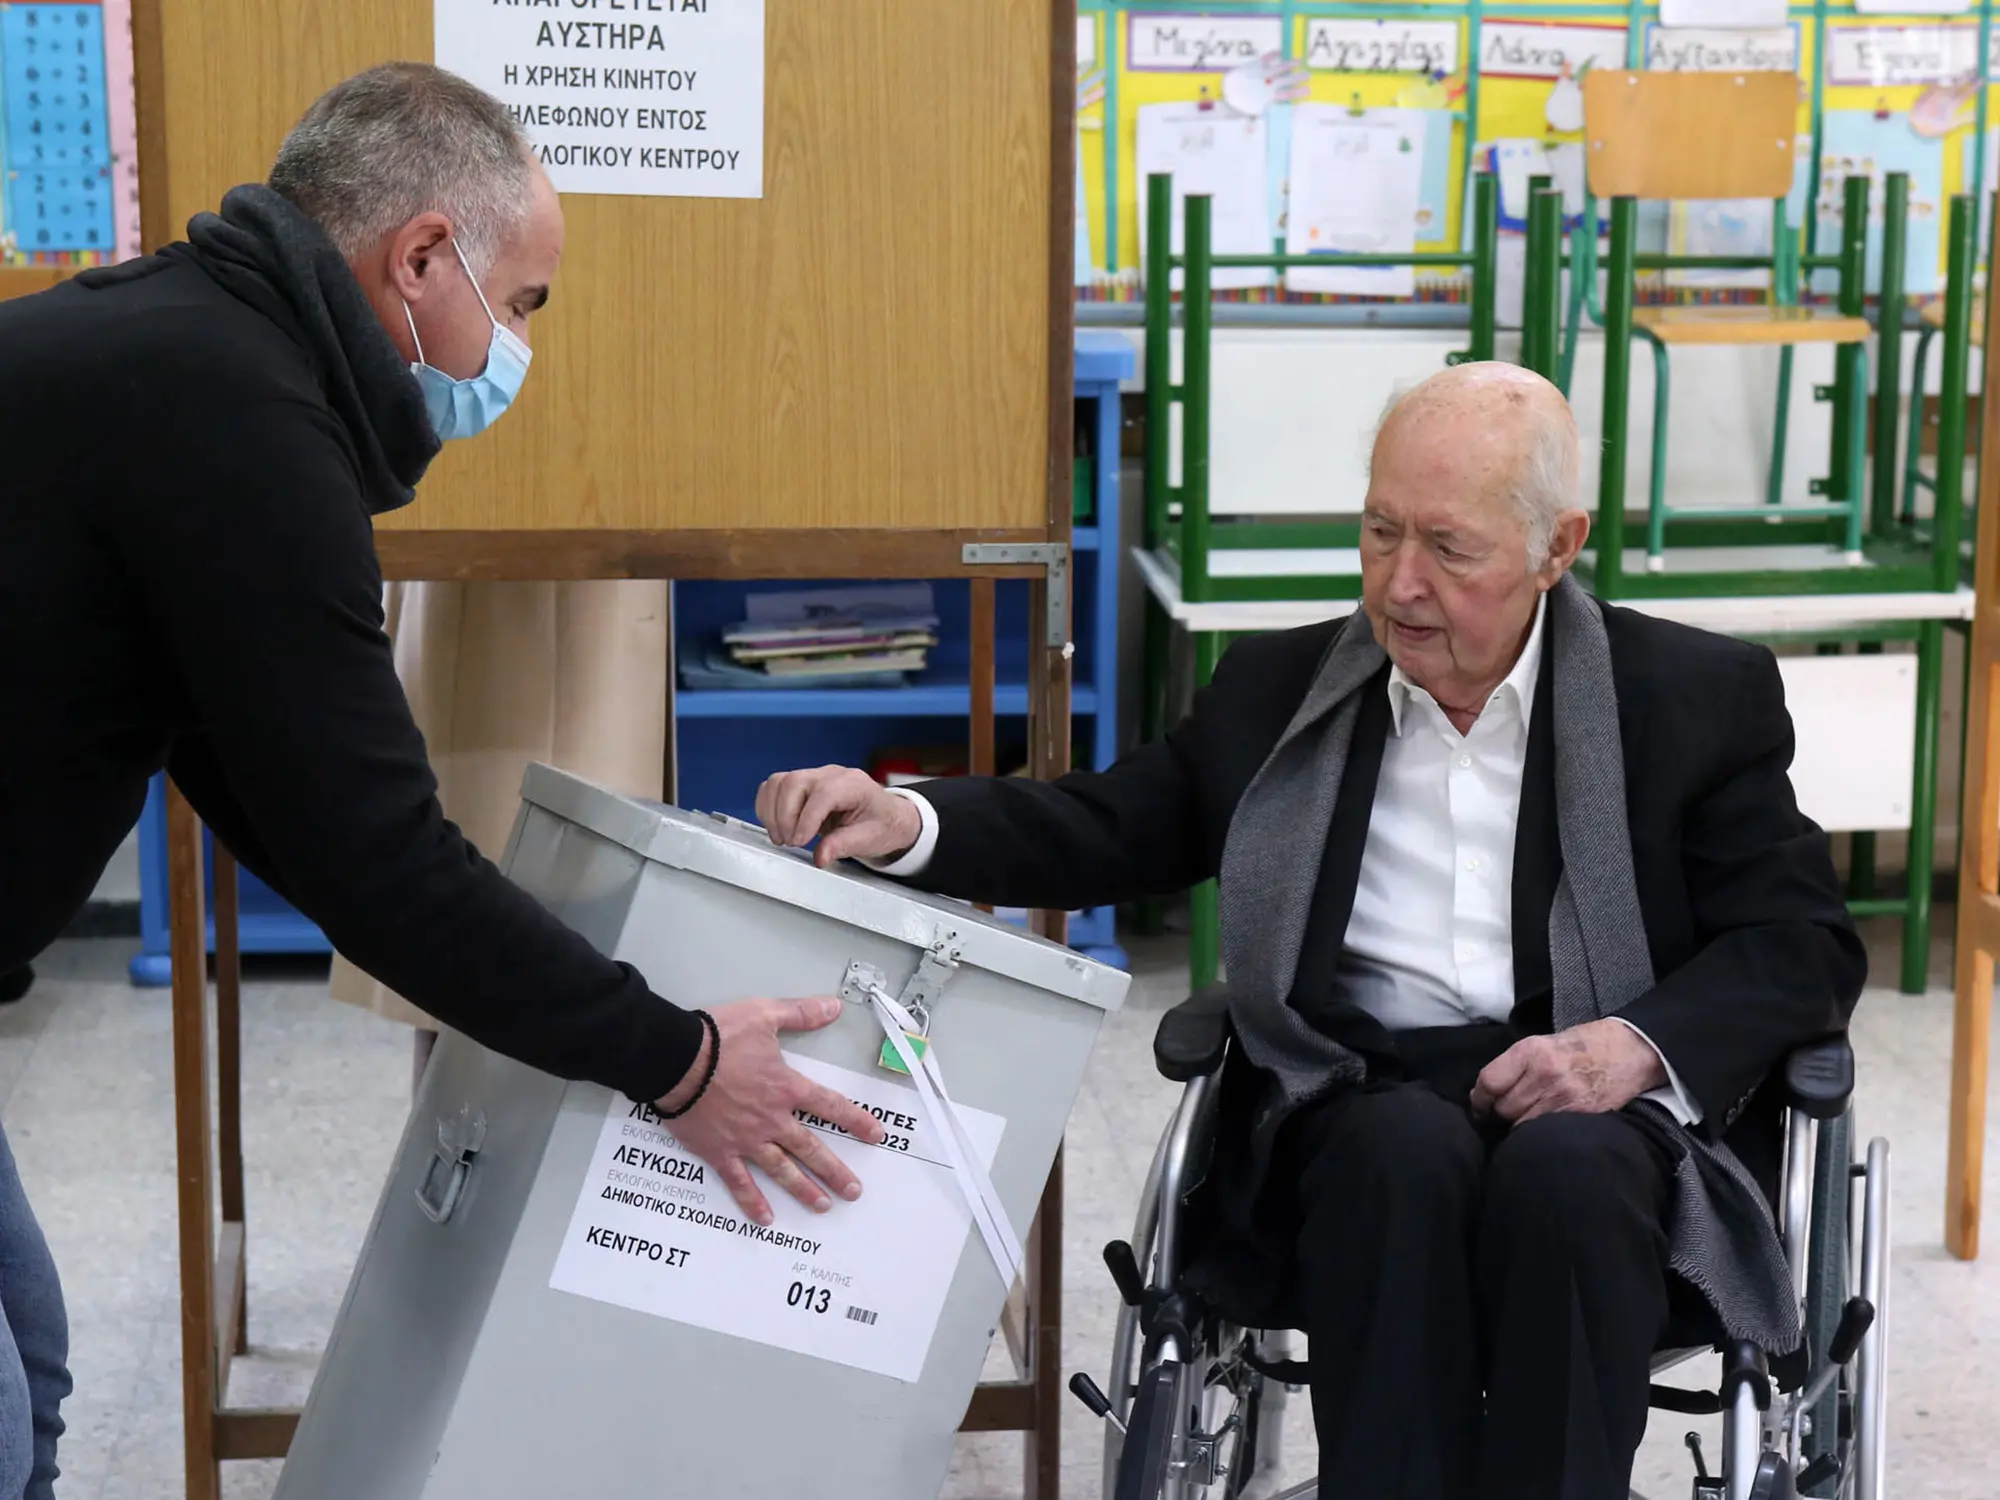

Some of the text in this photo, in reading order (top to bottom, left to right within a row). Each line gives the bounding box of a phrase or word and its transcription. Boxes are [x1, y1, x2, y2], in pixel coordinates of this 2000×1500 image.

[537, 21, 665, 51] ΑΥΣΤΗΡΑ
[504, 65, 697, 92] Η ΧΡΗΣΗ ΚΙΝΗΤΟΥ
[506, 104, 707, 131] ΗΛΕΦΩΝΟΥ ΕΝΤΟΣ
[532, 145, 740, 171] ΛΟΓΙΚΟΥ ΚΕΝΤΡΟΥ
[621, 1124, 676, 1148] ΕΚΛΟΓΙΚΟ
[613, 1145, 705, 1185] ΛΕΥΚΩΣΙΑ
[606, 1169, 706, 1205] ΕΚΛΟΓΙΚΟ ΚΕΝΤΡΟ
[601, 1186, 821, 1255] ΔΗΜΟΤΙΚΟ ΣΧΟΛΕΙΟ ΛΥΚΑΒΗΤΟΥ
[586, 1226, 690, 1268] ΚΕΝΤΡΟ ΣΤ
[810, 1266, 852, 1288] ΚΑΛΠΗΣ
[787, 1281, 831, 1314] 013
